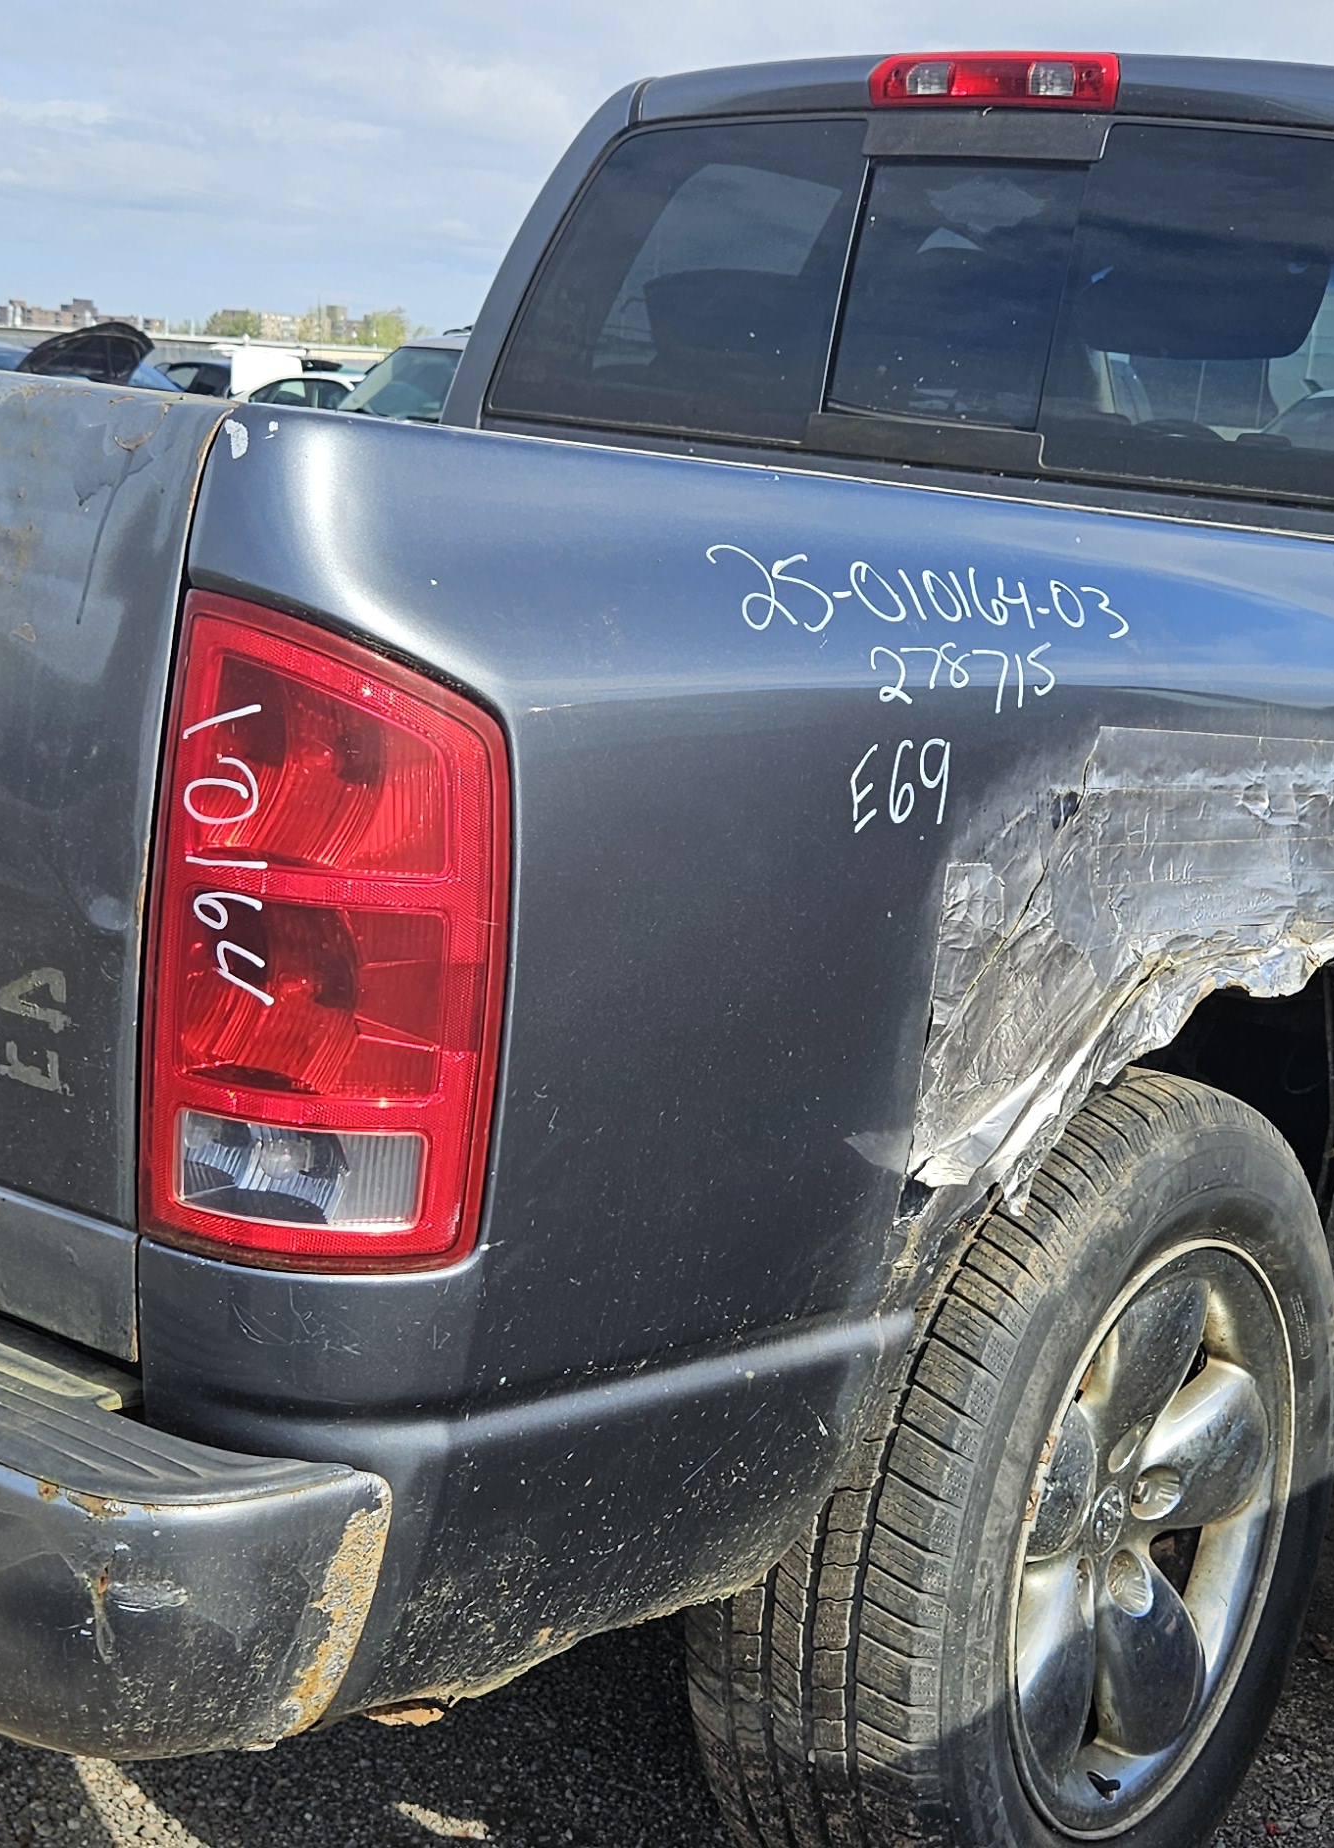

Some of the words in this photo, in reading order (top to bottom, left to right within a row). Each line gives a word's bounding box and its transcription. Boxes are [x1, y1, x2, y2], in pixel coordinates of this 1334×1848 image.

[705, 544, 1130, 639] 25-010164-03
[870, 641, 1057, 714] 278715
[849, 737, 951, 833] E69
